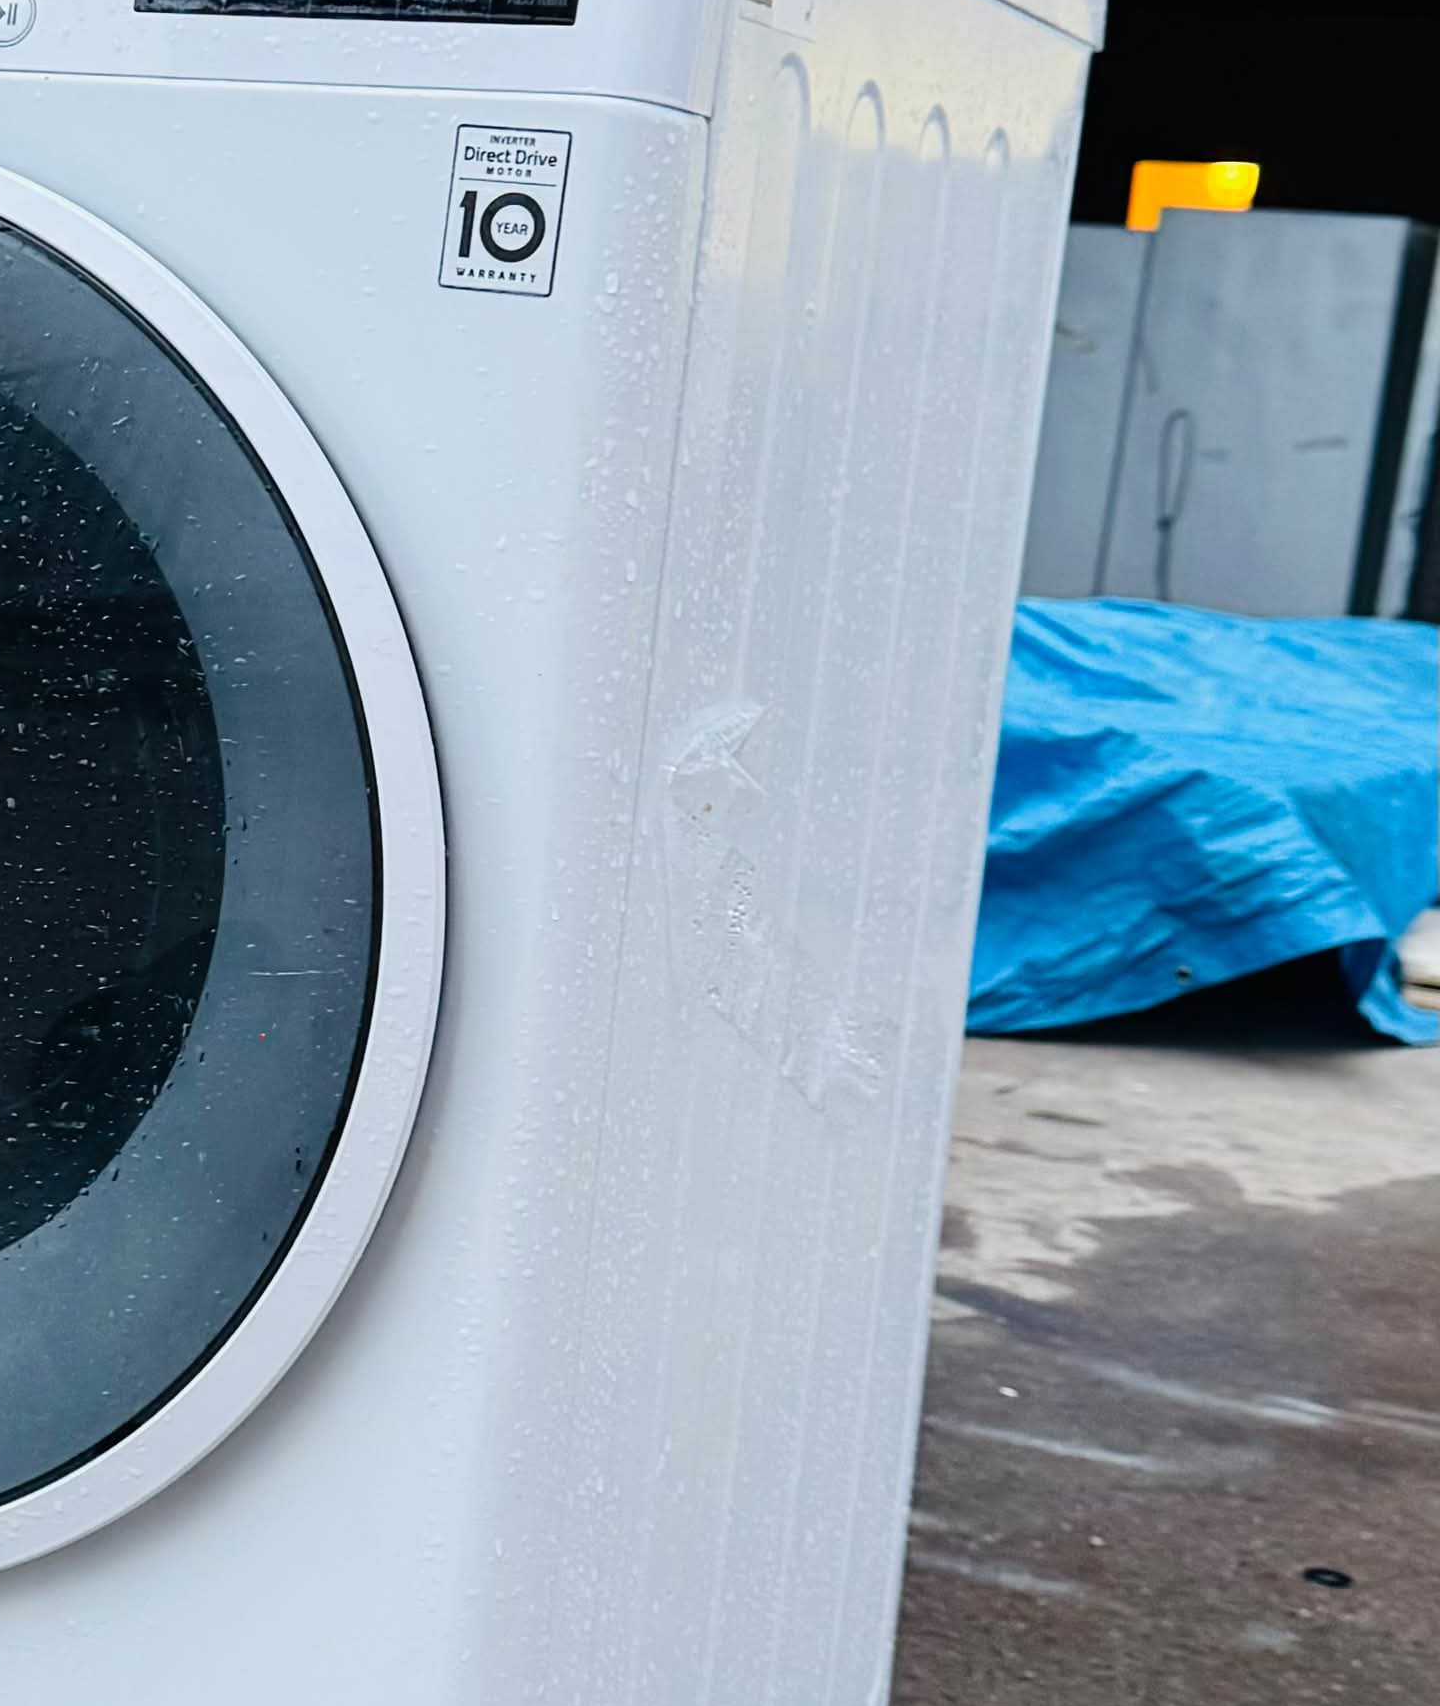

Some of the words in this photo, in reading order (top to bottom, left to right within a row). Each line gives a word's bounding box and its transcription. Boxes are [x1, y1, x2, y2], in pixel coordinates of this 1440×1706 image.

[490, 135, 536, 146] INVERTER
[464, 146, 511, 163] Direct
[515, 150, 557, 167] Drive
[486, 166, 532, 177] MOTOR
[458, 191, 546, 263] 10
[496, 222, 528, 235] YEAR
[456, 267, 537, 283] WARRANTY
